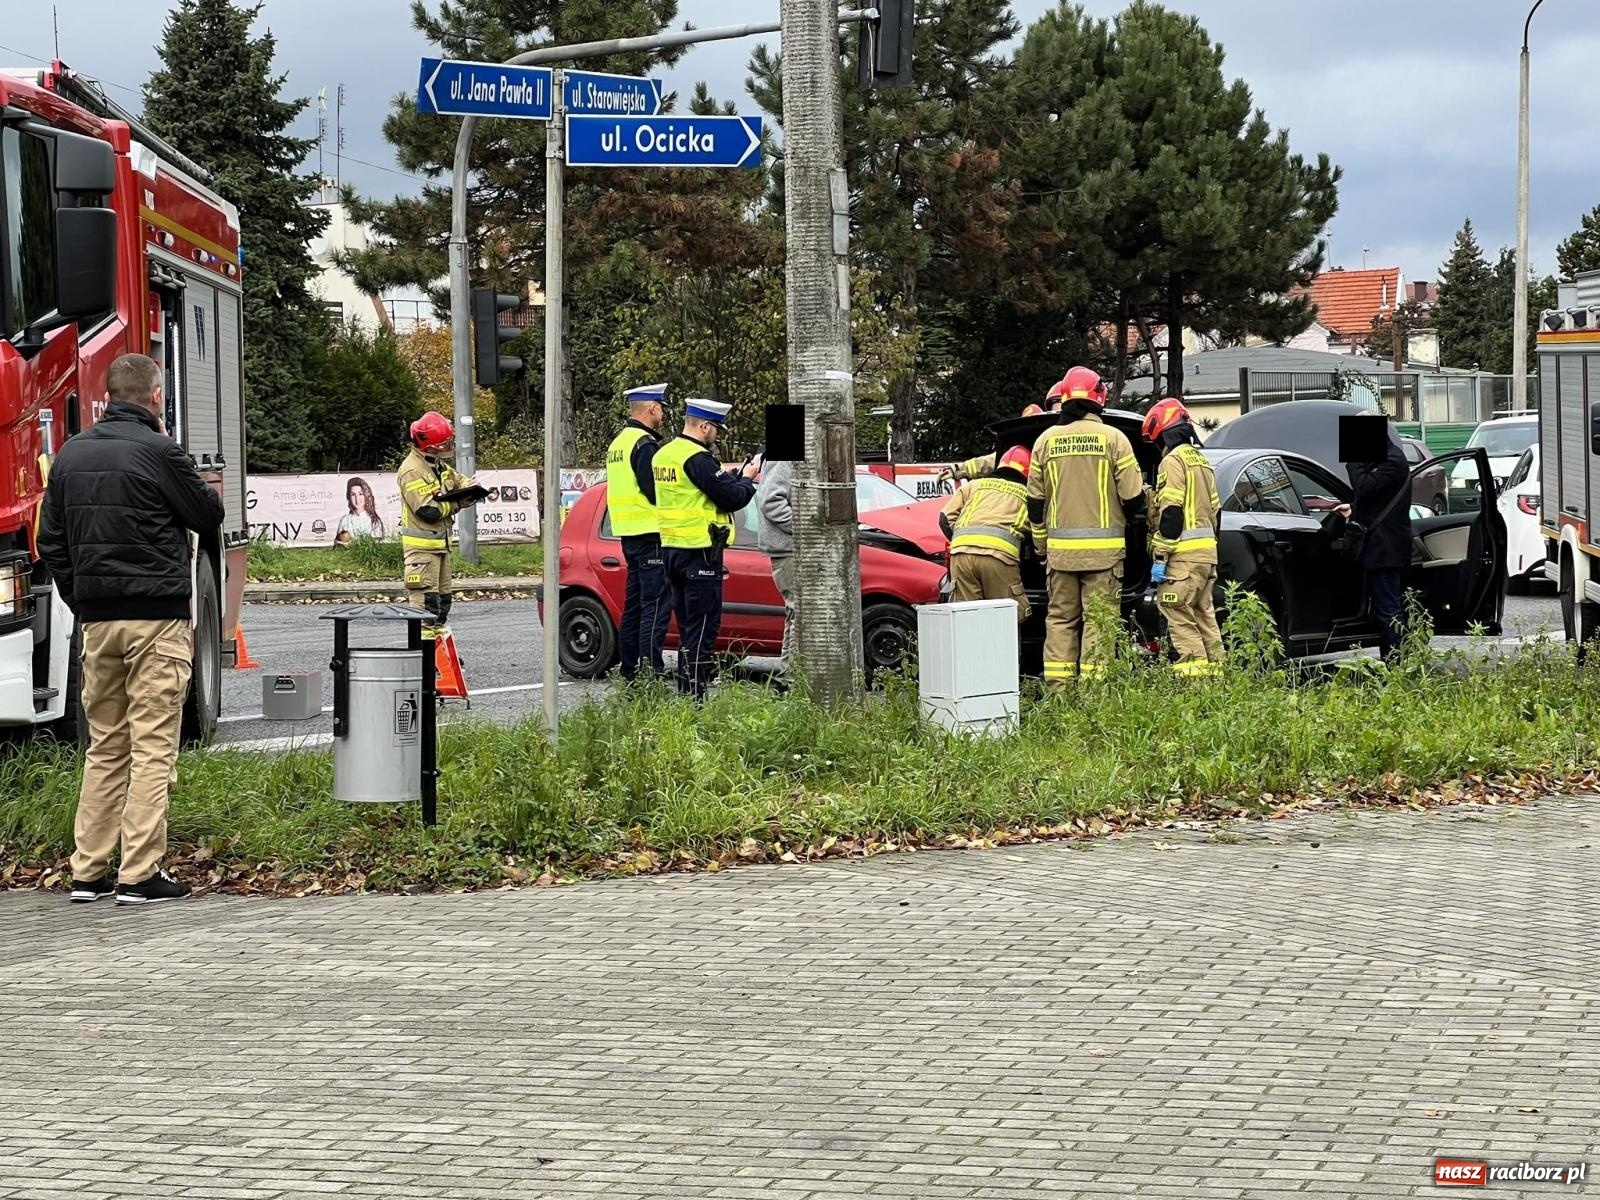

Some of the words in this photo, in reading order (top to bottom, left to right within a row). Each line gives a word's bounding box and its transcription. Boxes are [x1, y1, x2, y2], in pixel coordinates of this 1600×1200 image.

[451, 71, 464, 100] ul.
[467, 72, 496, 102] Jana
[500, 75, 533, 105] Pawła
[536, 78, 544, 106] II
[572, 81, 584, 108] ul.
[587, 82, 646, 115] Starowiejska
[601, 124, 628, 152] ul.
[635, 124, 714, 152] Ocicka
[653, 466, 677, 482] OLICJA
[273, 490, 297, 500] Ama
[310, 489, 334, 500] Ama
[483, 513, 503, 523] 005
[508, 512, 527, 522] 130
